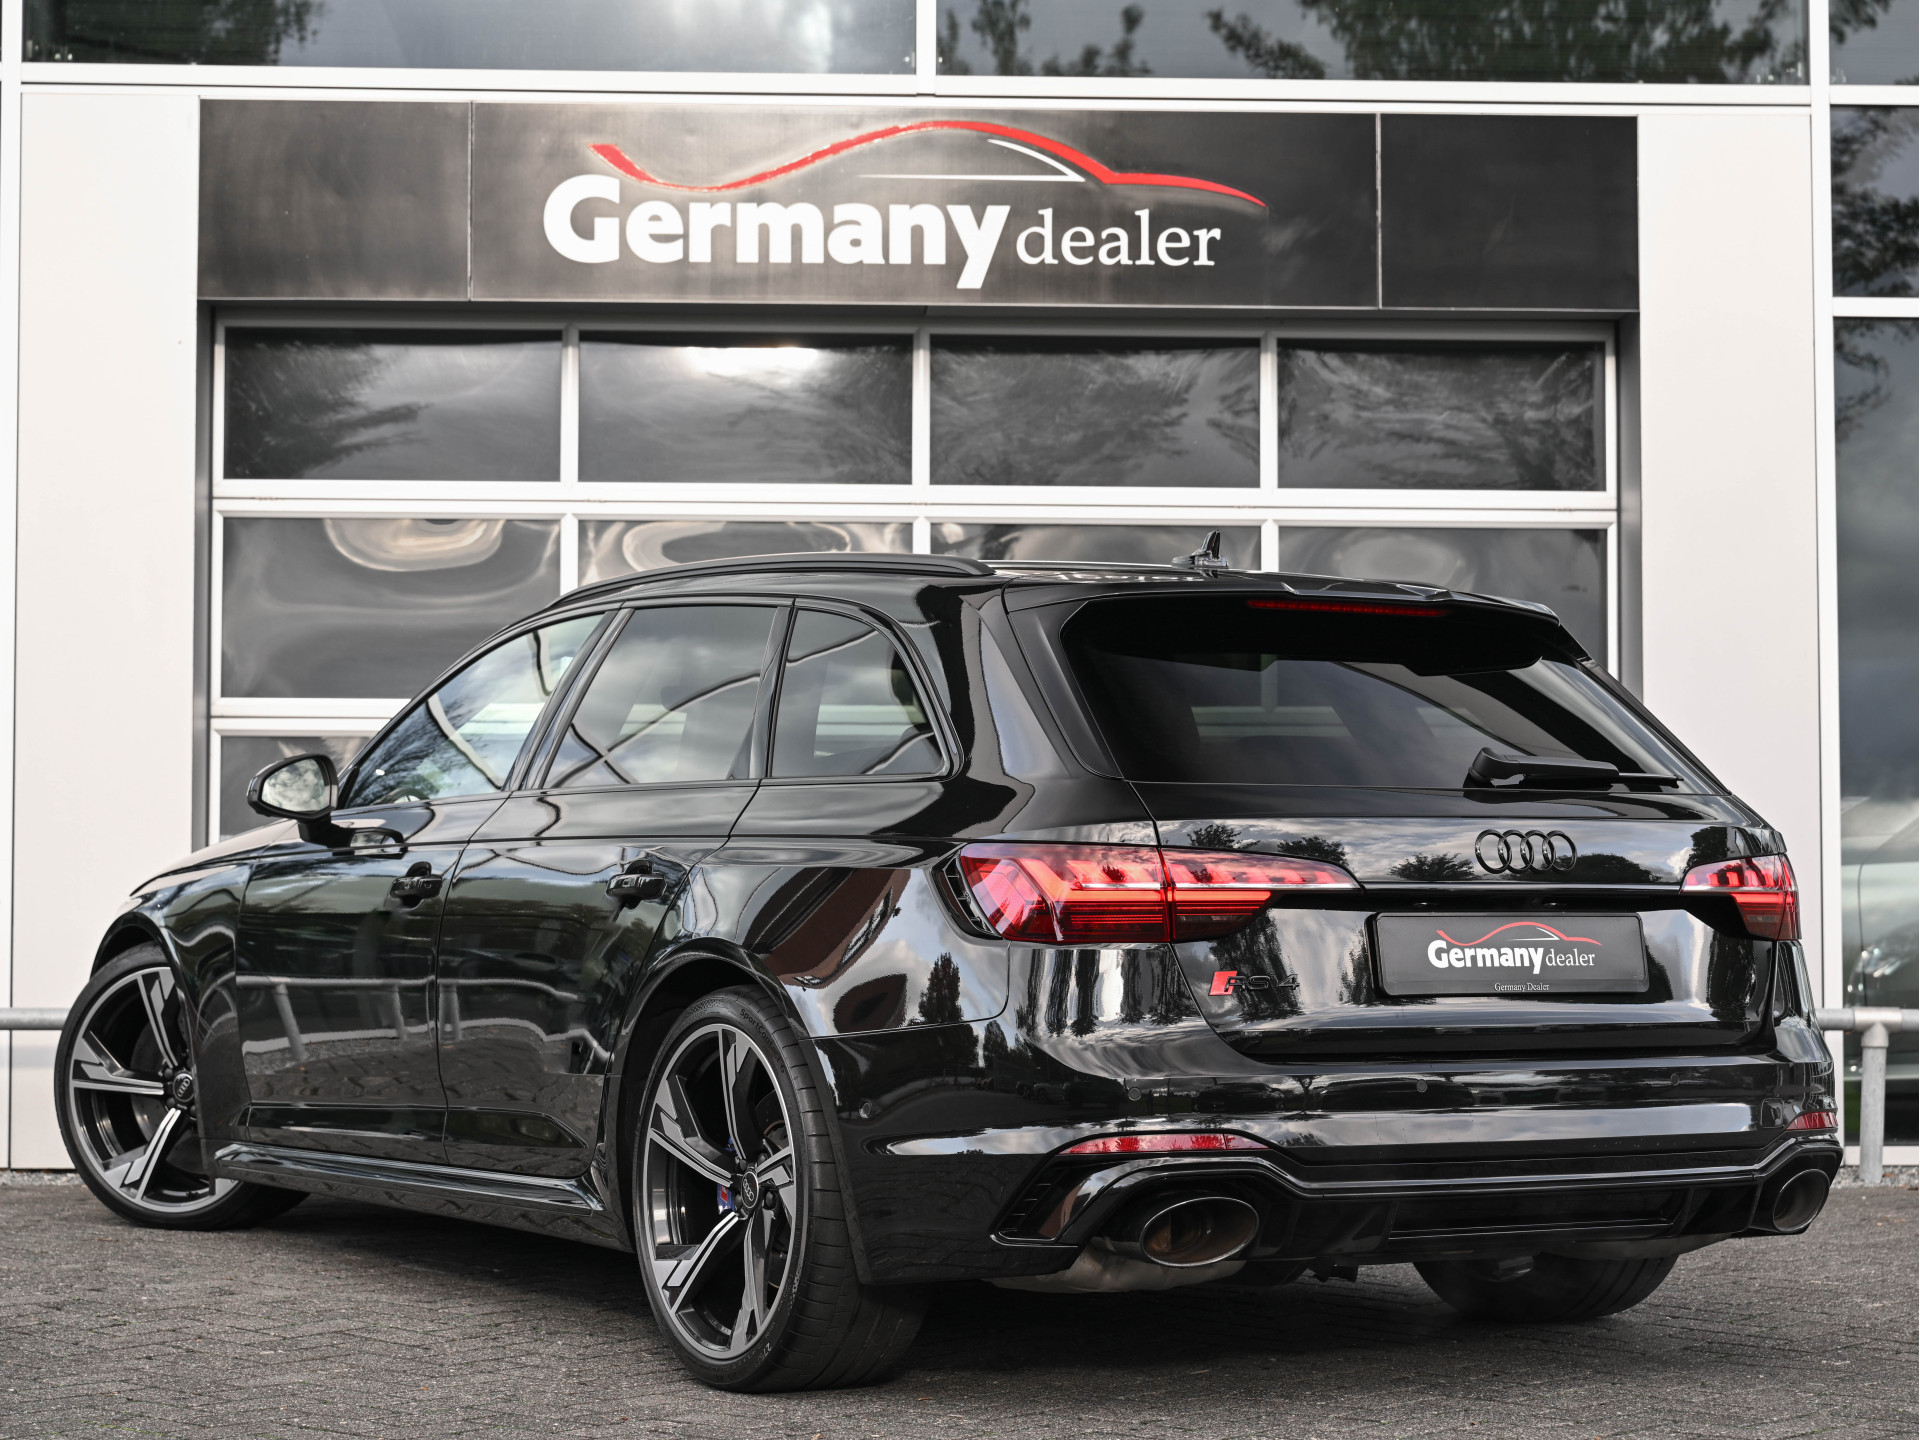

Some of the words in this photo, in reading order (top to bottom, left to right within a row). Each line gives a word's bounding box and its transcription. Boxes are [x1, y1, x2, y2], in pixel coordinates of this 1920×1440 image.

[543, 173, 1010, 290] Germany
[1015, 208, 1222, 267] dealer
[1427, 939, 1544, 975] Germany
[1545, 948, 1596, 967] dealer
[1494, 982, 1526, 992] Germany
[1526, 982, 1550, 991] Dealer
[739, 1008, 782, 1063] SportContact
